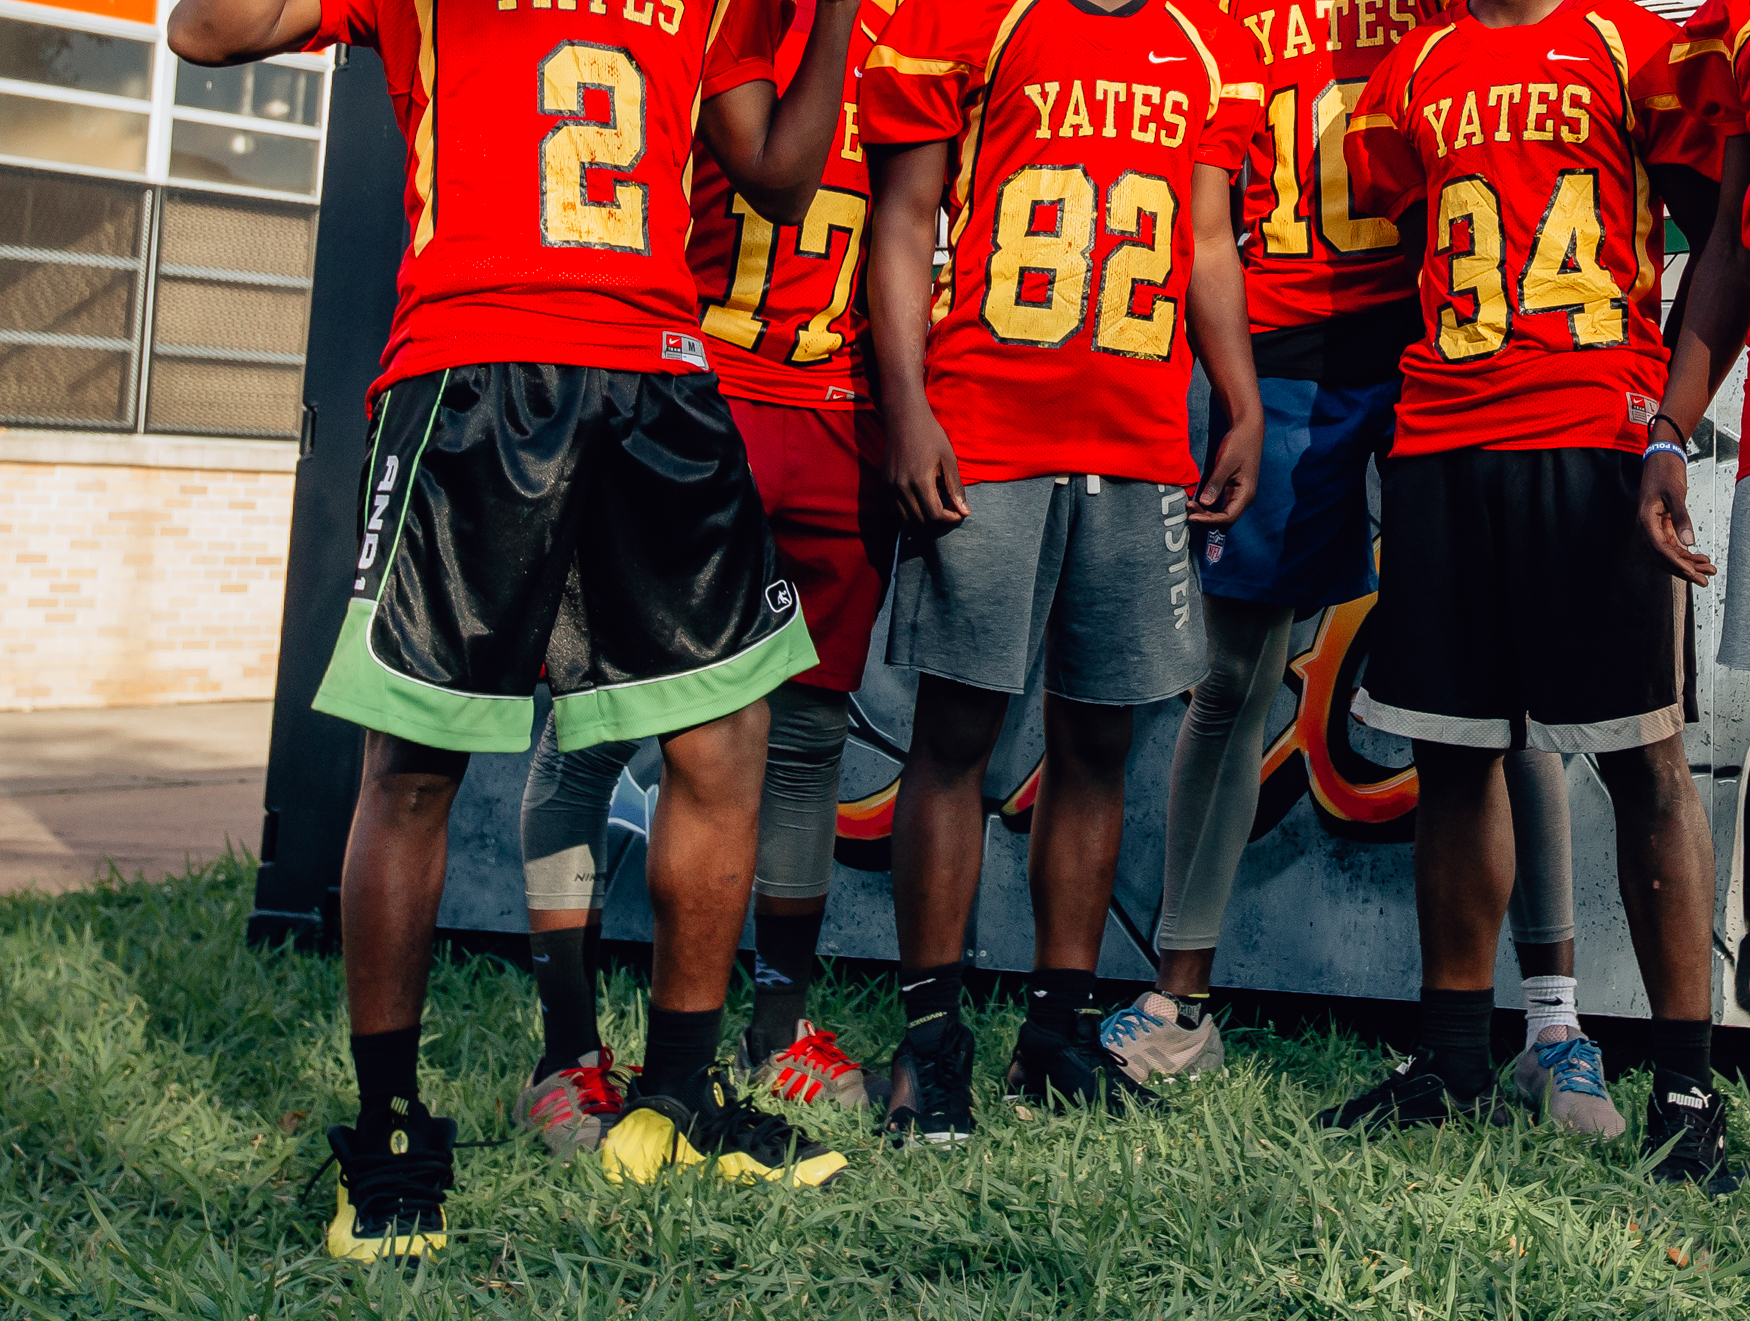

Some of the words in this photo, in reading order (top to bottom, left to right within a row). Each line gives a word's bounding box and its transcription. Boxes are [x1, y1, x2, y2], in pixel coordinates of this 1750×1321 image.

[537, 39, 652, 256] 2
[1025, 79, 1190, 149] YATES
[1423, 81, 1593, 160] YATES
[701, 185, 870, 366] 17
[978, 163, 1181, 363] 82
[1432, 167, 1630, 364] 34
[1158, 484, 1190, 630] LISTER
